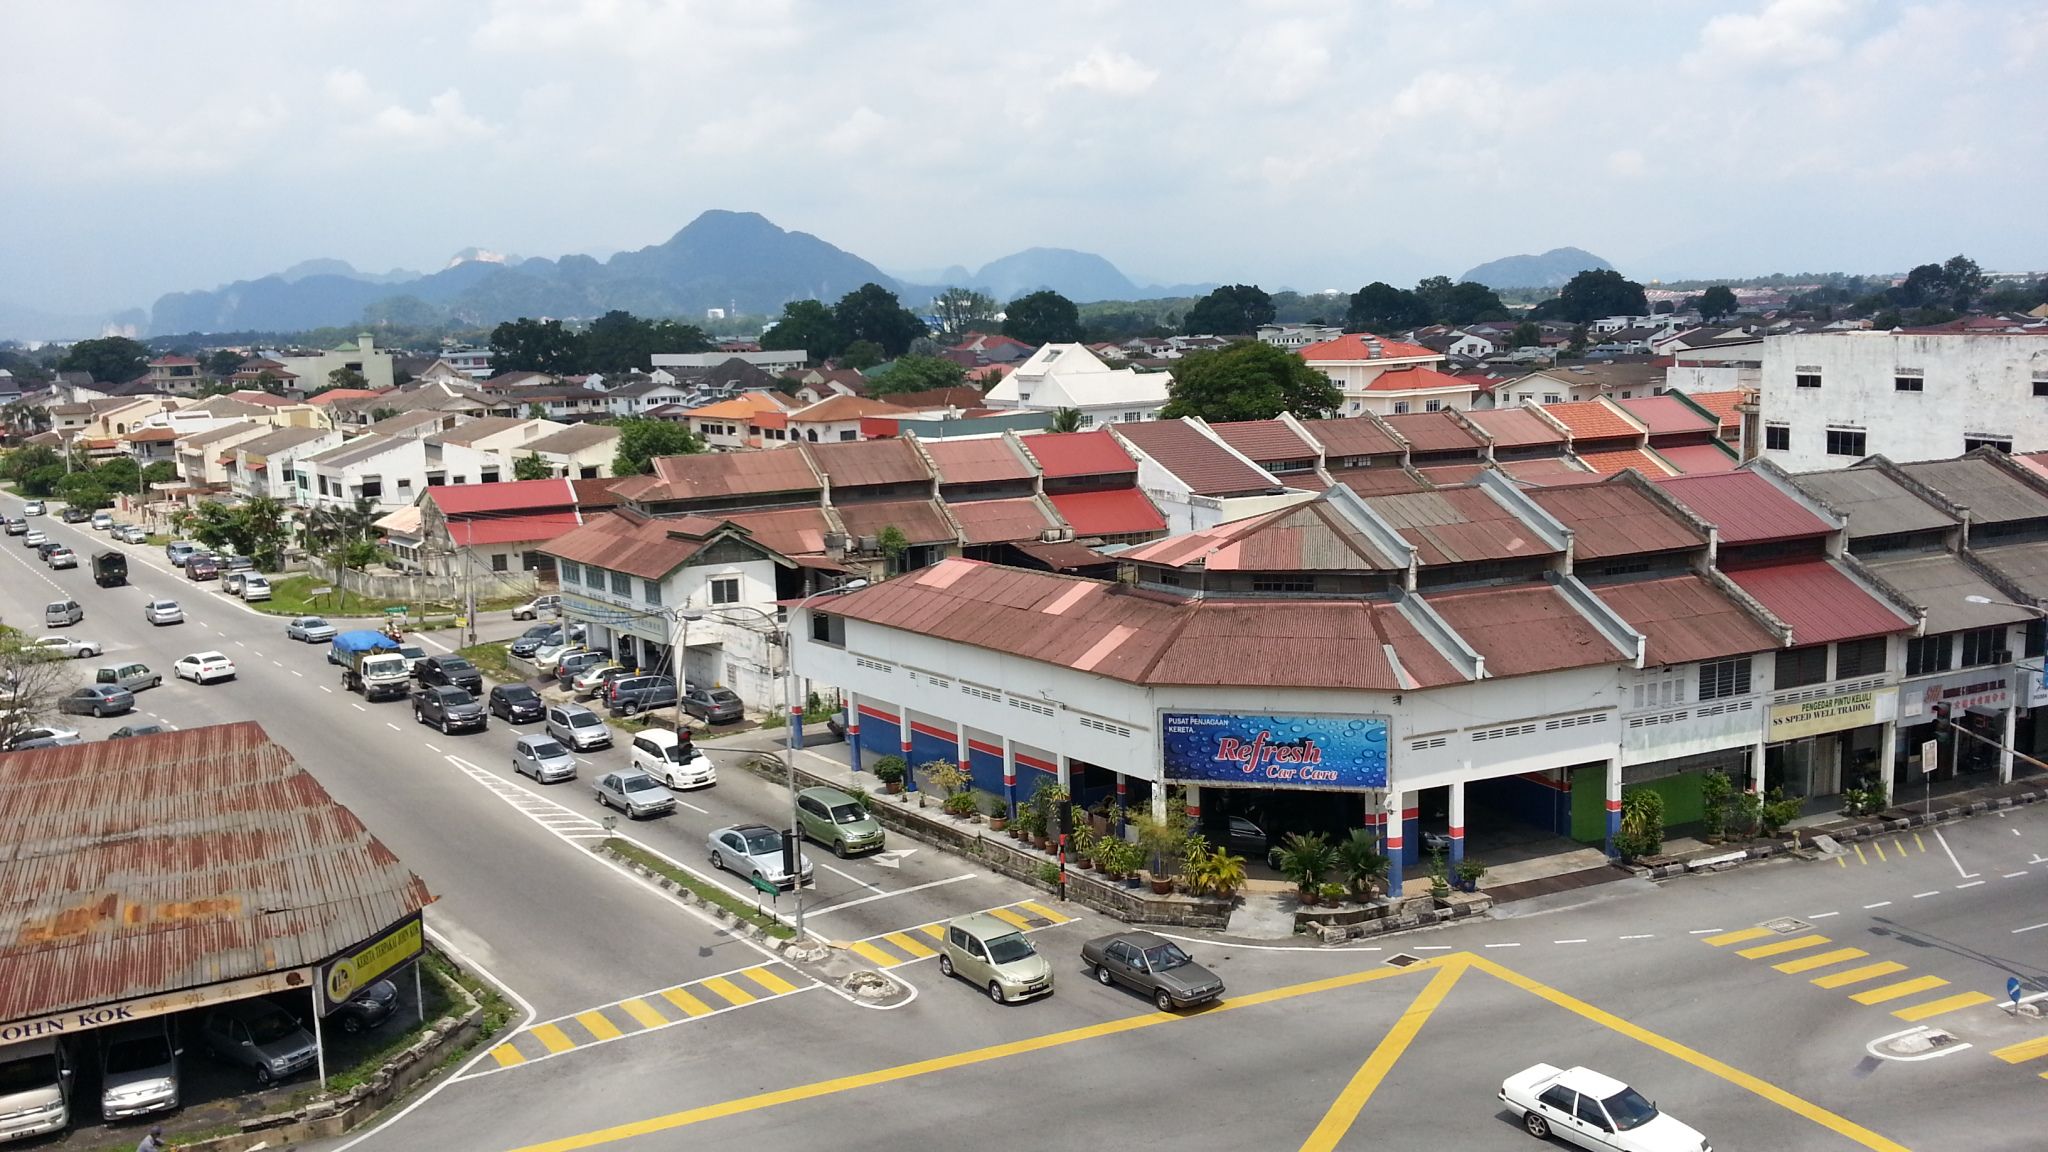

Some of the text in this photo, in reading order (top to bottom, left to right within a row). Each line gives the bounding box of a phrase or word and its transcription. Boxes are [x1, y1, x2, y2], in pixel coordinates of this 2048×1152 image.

[1801, 692, 1872, 712] PENGEDAR PINTU KELULI
[1168, 717, 1229, 726] PUSAT PENJAGAAN
[1773, 703, 1870, 726] SS SPEED WELL TRADING
[1168, 726, 1194, 734] KERETA
[1215, 730, 1322, 773] Refresh
[1266, 764, 1338, 780] Car Care
[78, 1005, 132, 1026] KOK
